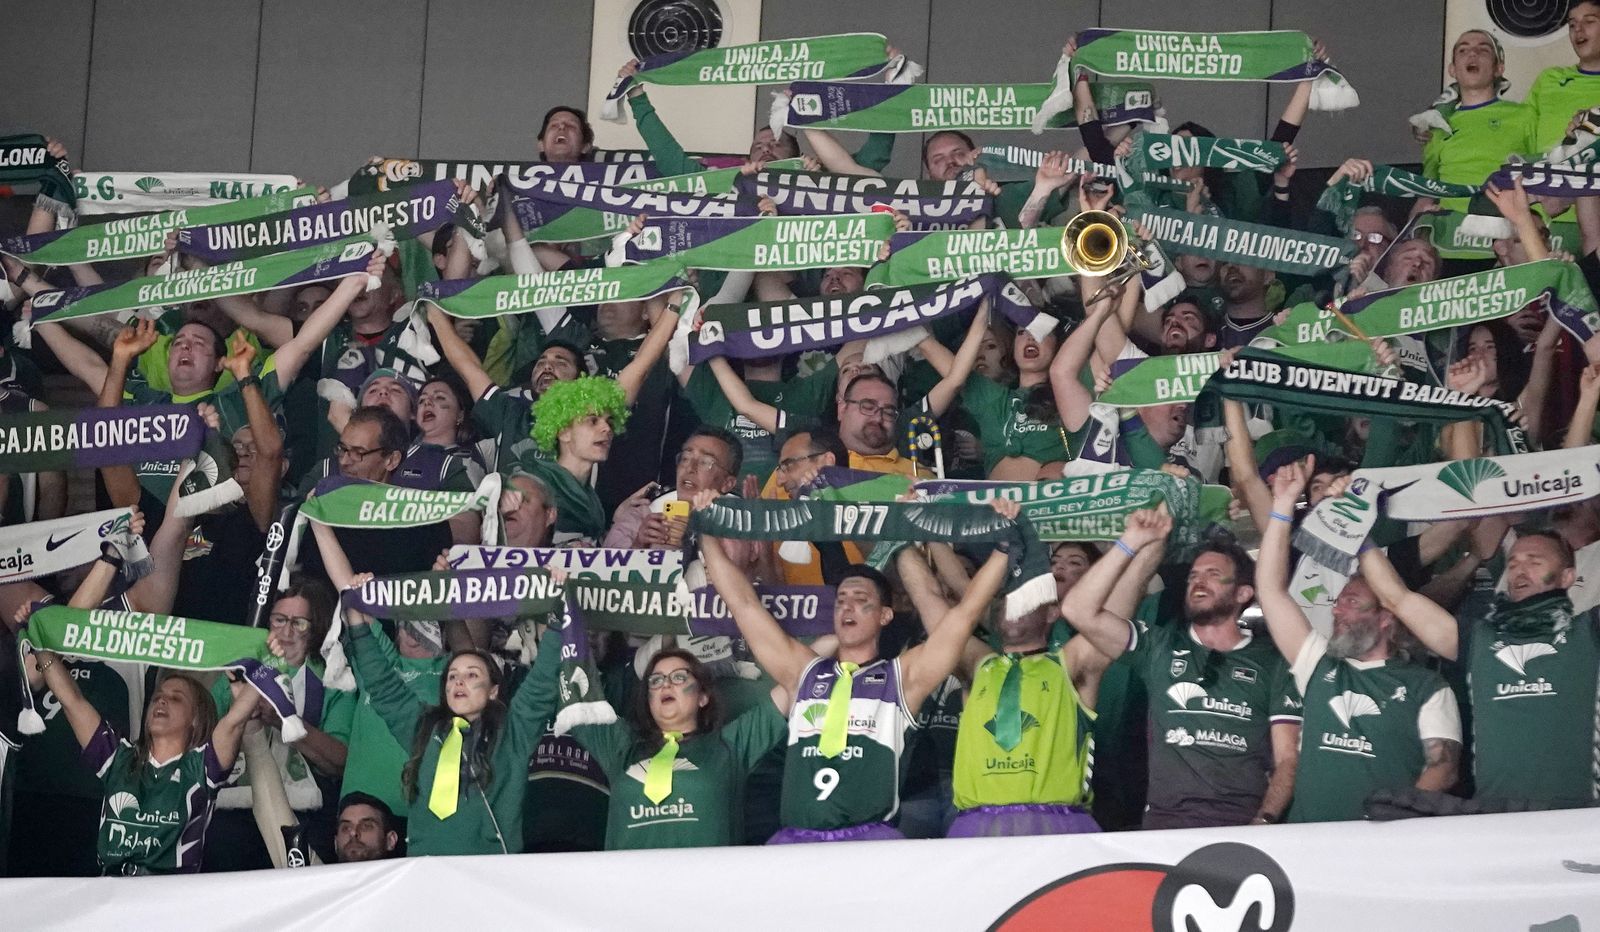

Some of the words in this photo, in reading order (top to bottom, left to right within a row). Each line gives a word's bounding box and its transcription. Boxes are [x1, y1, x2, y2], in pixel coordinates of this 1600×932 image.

[724, 42, 809, 66] UNICAJA
[1135, 34, 1222, 53] UNICAJA
[699, 61, 825, 82] BALONCESTO
[1116, 52, 1243, 75] BALONCESTO
[929, 87, 1017, 107] UNICAJA
[911, 106, 1037, 127] BALONCESTO
[757, 173, 985, 217] UNICAJA
[104, 210, 189, 236] UNICAJA
[775, 219, 867, 243] UNICAJA
[754, 239, 884, 266] BALONCESTO
[946, 229, 1039, 256] UNICAJA
[1142, 212, 1219, 251] UNICAJA
[1224, 228, 1341, 269] BALONCESTO
[927, 247, 1060, 279] BALONCESTO
[138, 267, 258, 303] BALONCESTO
[517, 268, 603, 288] UNICAJA
[1419, 270, 1507, 303] UNICAJA
[495, 281, 620, 311] BALONCESTO
[1399, 287, 1527, 329] BALONCESTO
[747, 274, 985, 350] UNICAJA
[1224, 359, 1282, 384] CLUB
[1286, 365, 1399, 400] JOVENTUT
[1503, 469, 1583, 498] Unicaja
[1028, 506, 1054, 516] DEL
[1058, 502, 1085, 512] REY
[1089, 495, 1122, 508] 2005
[833, 505, 889, 534] 1977
[89, 609, 188, 636] UNICAJA
[62, 622, 205, 664] BALONCESTO
[1497, 675, 1554, 697] Unicaja
[1203, 697, 1253, 717] Unicaja
[1322, 731, 1373, 752] Unicaja
[985, 752, 1036, 772] Unicaja
[813, 767, 841, 801] 9
[630, 797, 695, 820] Unicaja
